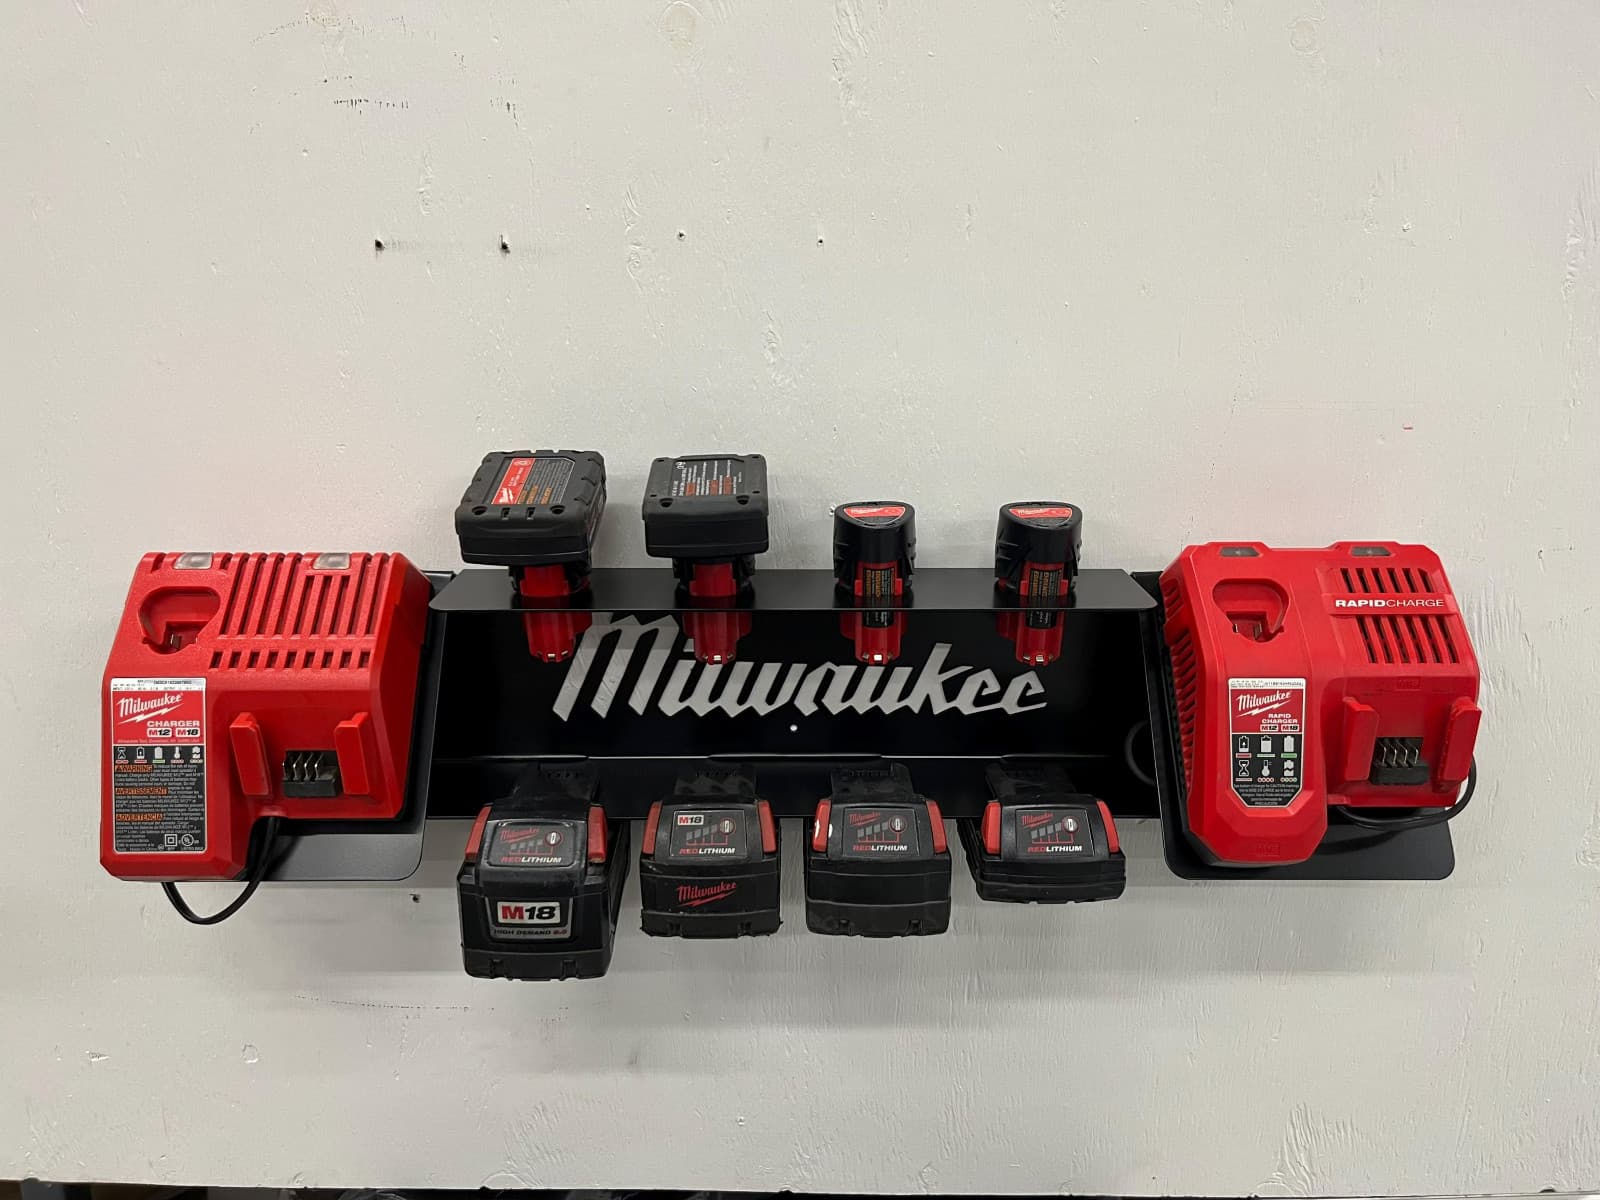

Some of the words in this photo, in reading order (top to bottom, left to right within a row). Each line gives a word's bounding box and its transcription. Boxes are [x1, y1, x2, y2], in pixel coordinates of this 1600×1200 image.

[1335, 599, 1444, 608] RAPIDCHARGE
[552, 611, 1048, 722] Milwaukee
[116, 692, 183, 717] Milwaukee
[1236, 690, 1291, 711] Milwaukee
[147, 720, 200, 728] CHARGER
[679, 816, 703, 824] M18
[679, 847, 736, 855] REDLITHIUM
[677, 881, 737, 902] Milwaukee
[501, 905, 557, 920] M18
[516, 928, 551, 936] DEMAND
